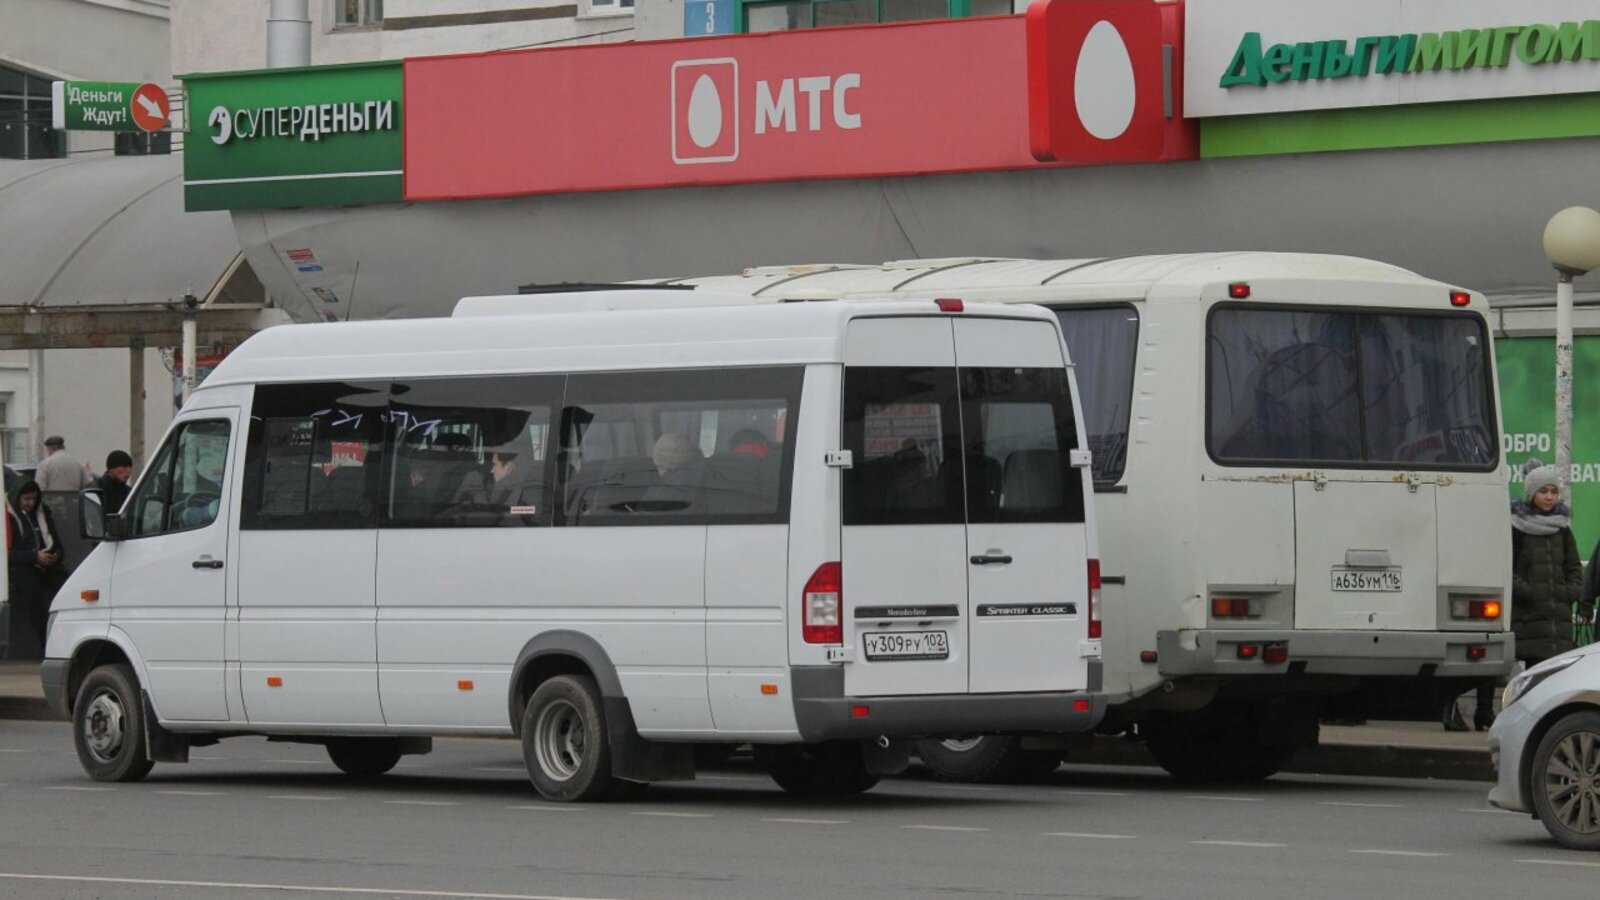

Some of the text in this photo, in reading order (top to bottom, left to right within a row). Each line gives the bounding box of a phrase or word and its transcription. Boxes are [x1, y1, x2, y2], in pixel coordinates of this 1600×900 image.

[706, 2, 715, 33] 3
[1219, 20, 1600, 88] Деньгимигом
[69, 87, 122, 105] Деньги
[754, 73, 862, 134] МТС
[83, 107, 127, 126] Ждут!
[234, 100, 392, 141] СУПЕРДЕНЬГИ
[1335, 573, 1400, 588] А636УМ 116
[1031, 606, 1068, 614] CLASSIC
[870, 633, 943, 653] У309РУ 102
